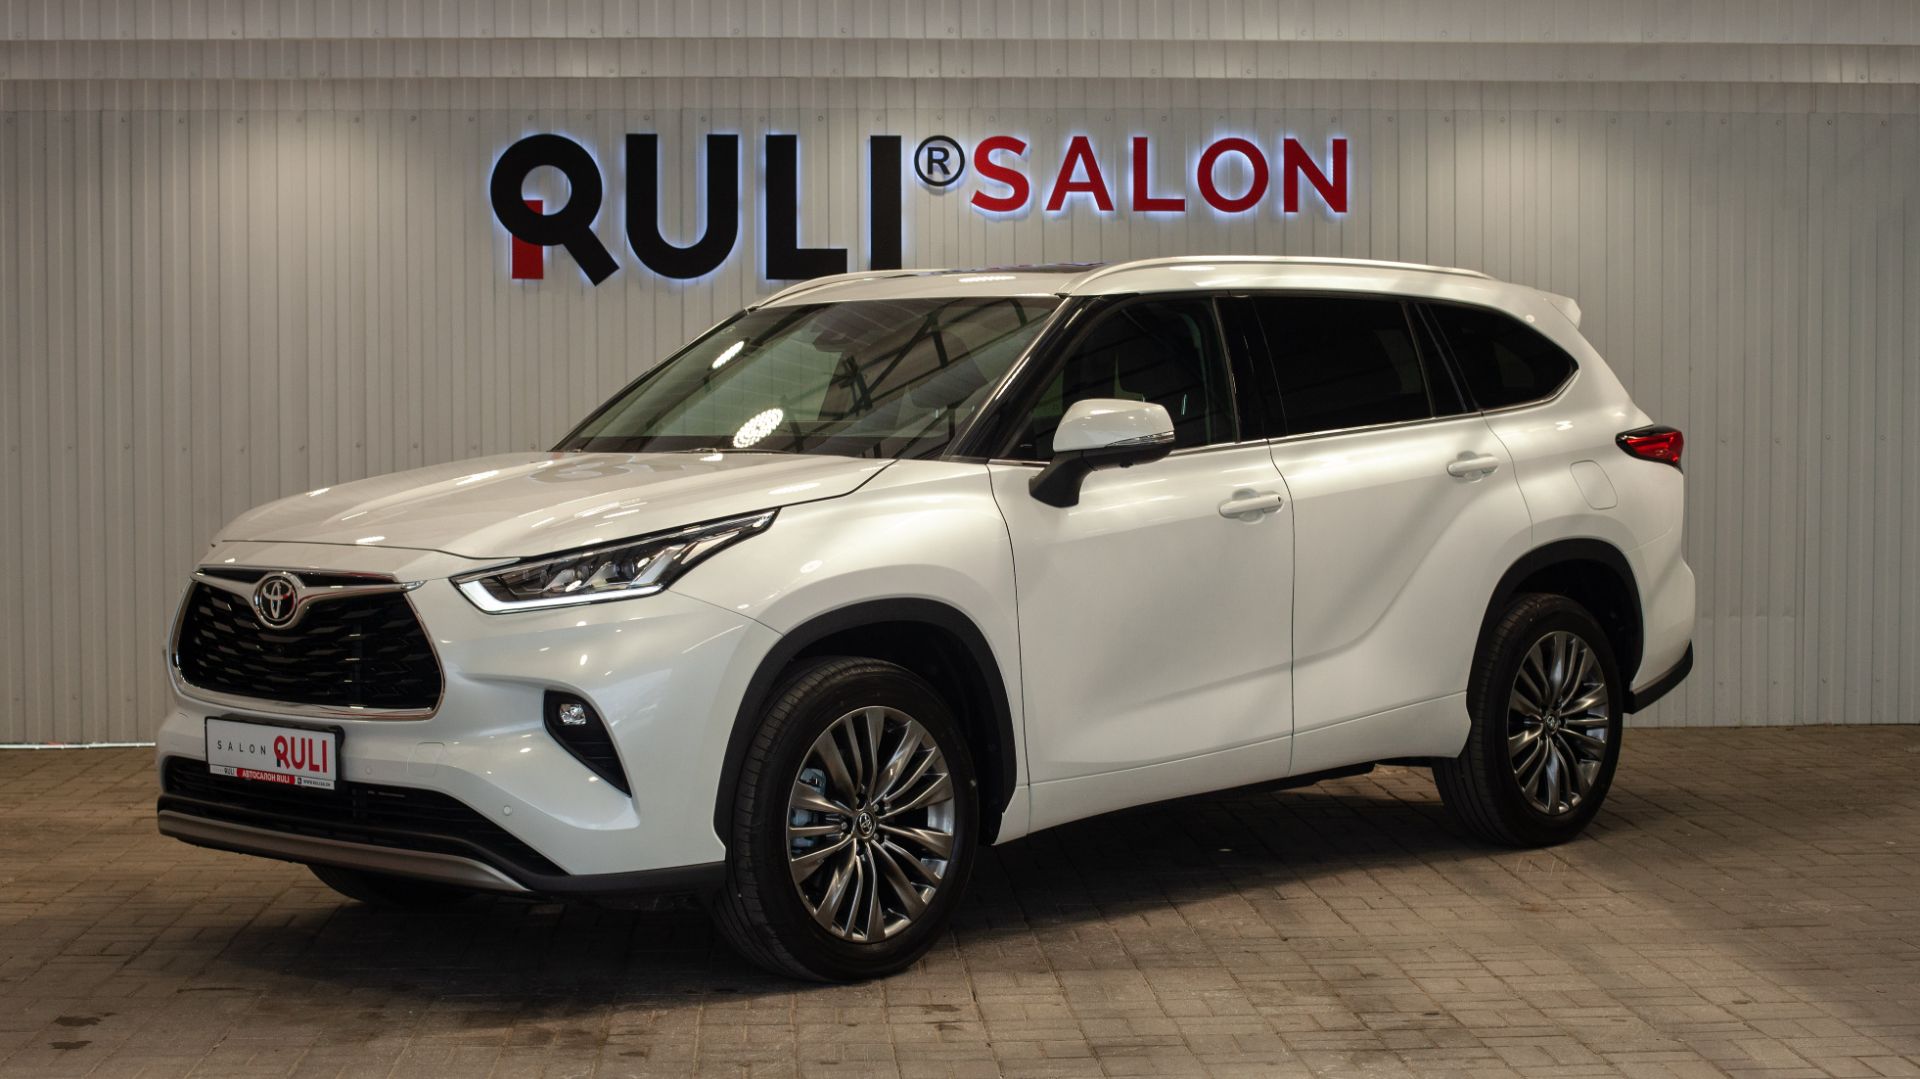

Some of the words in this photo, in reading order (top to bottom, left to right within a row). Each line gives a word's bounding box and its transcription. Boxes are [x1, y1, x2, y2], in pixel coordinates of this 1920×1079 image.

[971, 136, 1347, 212] SALON
[217, 740, 266, 756] SALON
[242, 770, 276, 782] АВТОСАЛОН
[276, 774, 290, 784] RULI
